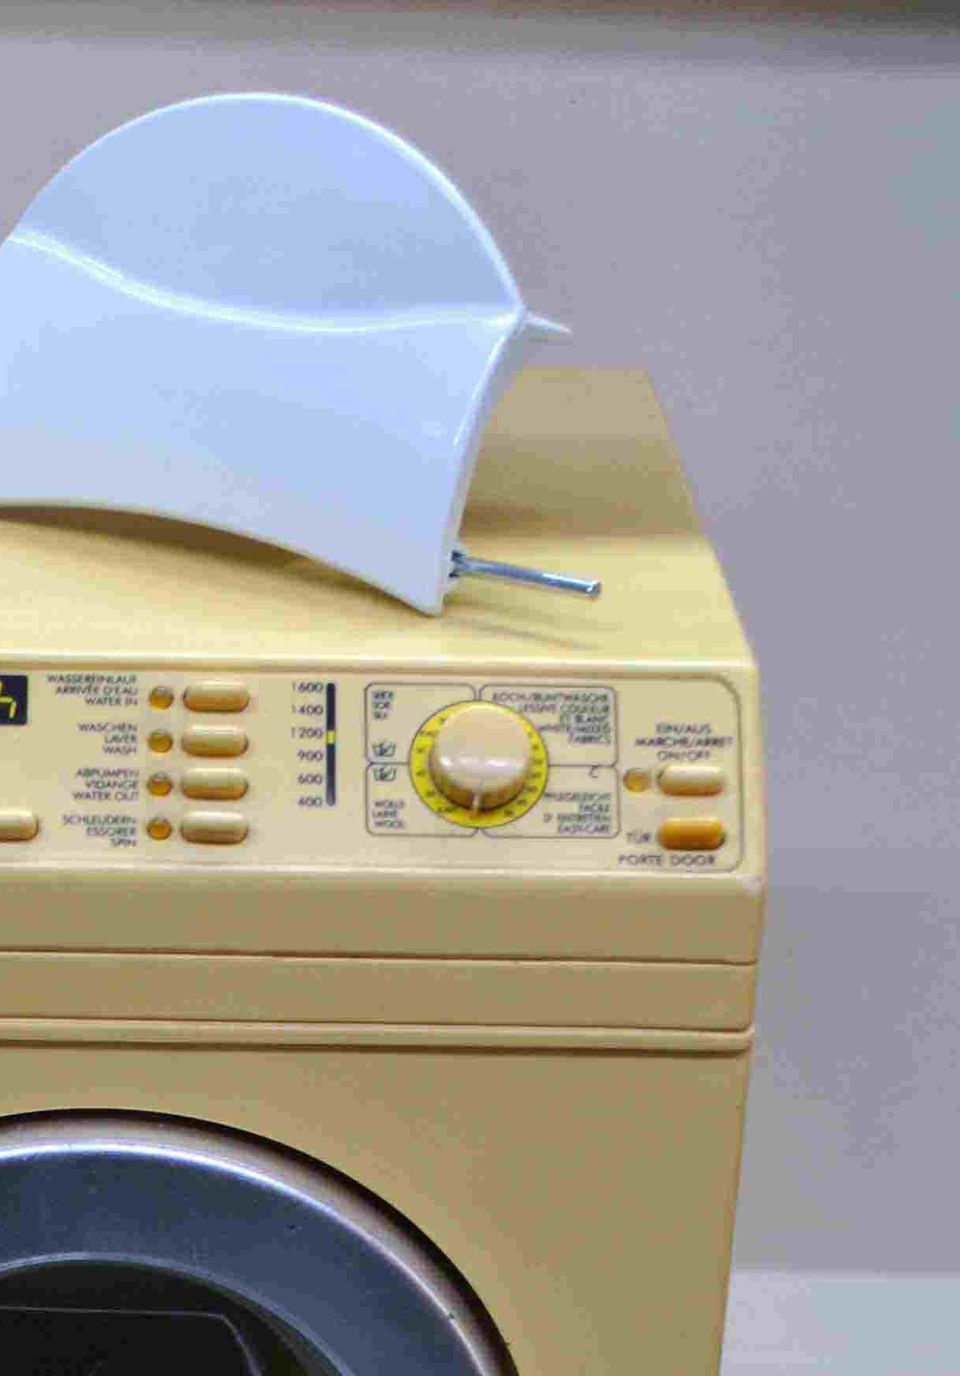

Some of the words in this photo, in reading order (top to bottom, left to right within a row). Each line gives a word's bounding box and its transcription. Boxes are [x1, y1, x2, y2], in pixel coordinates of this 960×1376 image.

[291, 681, 324, 694] 1600
[84, 696, 122, 706] WATER
[124, 696, 139, 706] IN
[290, 705, 324, 716] 1400
[77, 723, 138, 733] WASCHEN
[290, 727, 324, 740] 1200
[656, 722, 711, 734] EIN/AUS
[105, 734, 138, 744] LAVER
[102, 745, 138, 755] WASH
[297, 750, 323, 762] 900
[85, 779, 139, 790] VIDANGE
[297, 773, 323, 786] 600
[71, 791, 112, 801] WATER
[114, 791, 140, 802] OUT
[63, 814, 138, 825] SCHLEUDERN
[109, 838, 138, 849] SPIN
[618, 854, 663, 866] PORTE
[670, 854, 715, 866] DOOR
